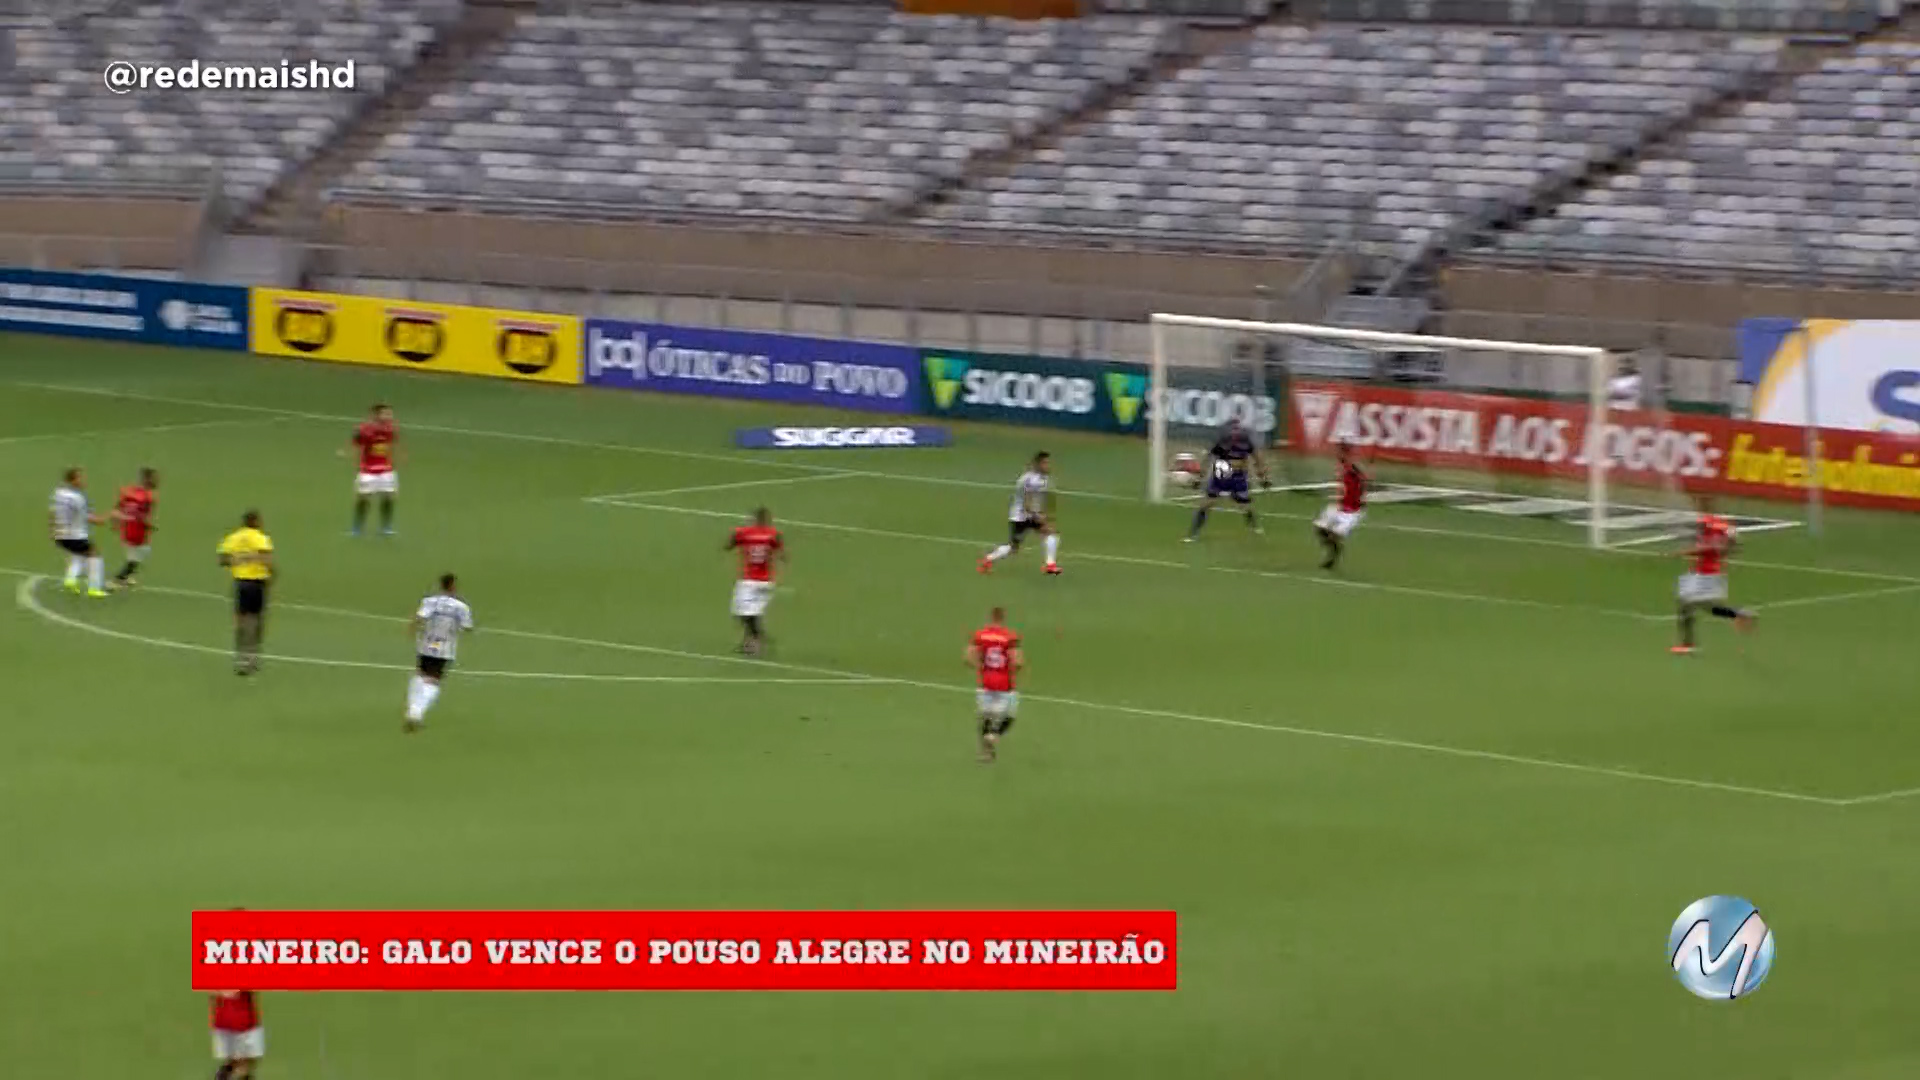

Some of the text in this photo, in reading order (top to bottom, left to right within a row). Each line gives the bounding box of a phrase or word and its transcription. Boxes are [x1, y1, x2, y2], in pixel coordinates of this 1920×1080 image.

[648, 340, 771, 385] ÓTICAS
[811, 360, 909, 399] POVO
[962, 368, 1095, 415] SICOOB
[772, 426, 916, 446] SUGGAR
[1328, 400, 1481, 455] ASSISTA
[1487, 413, 1571, 463] AOS
